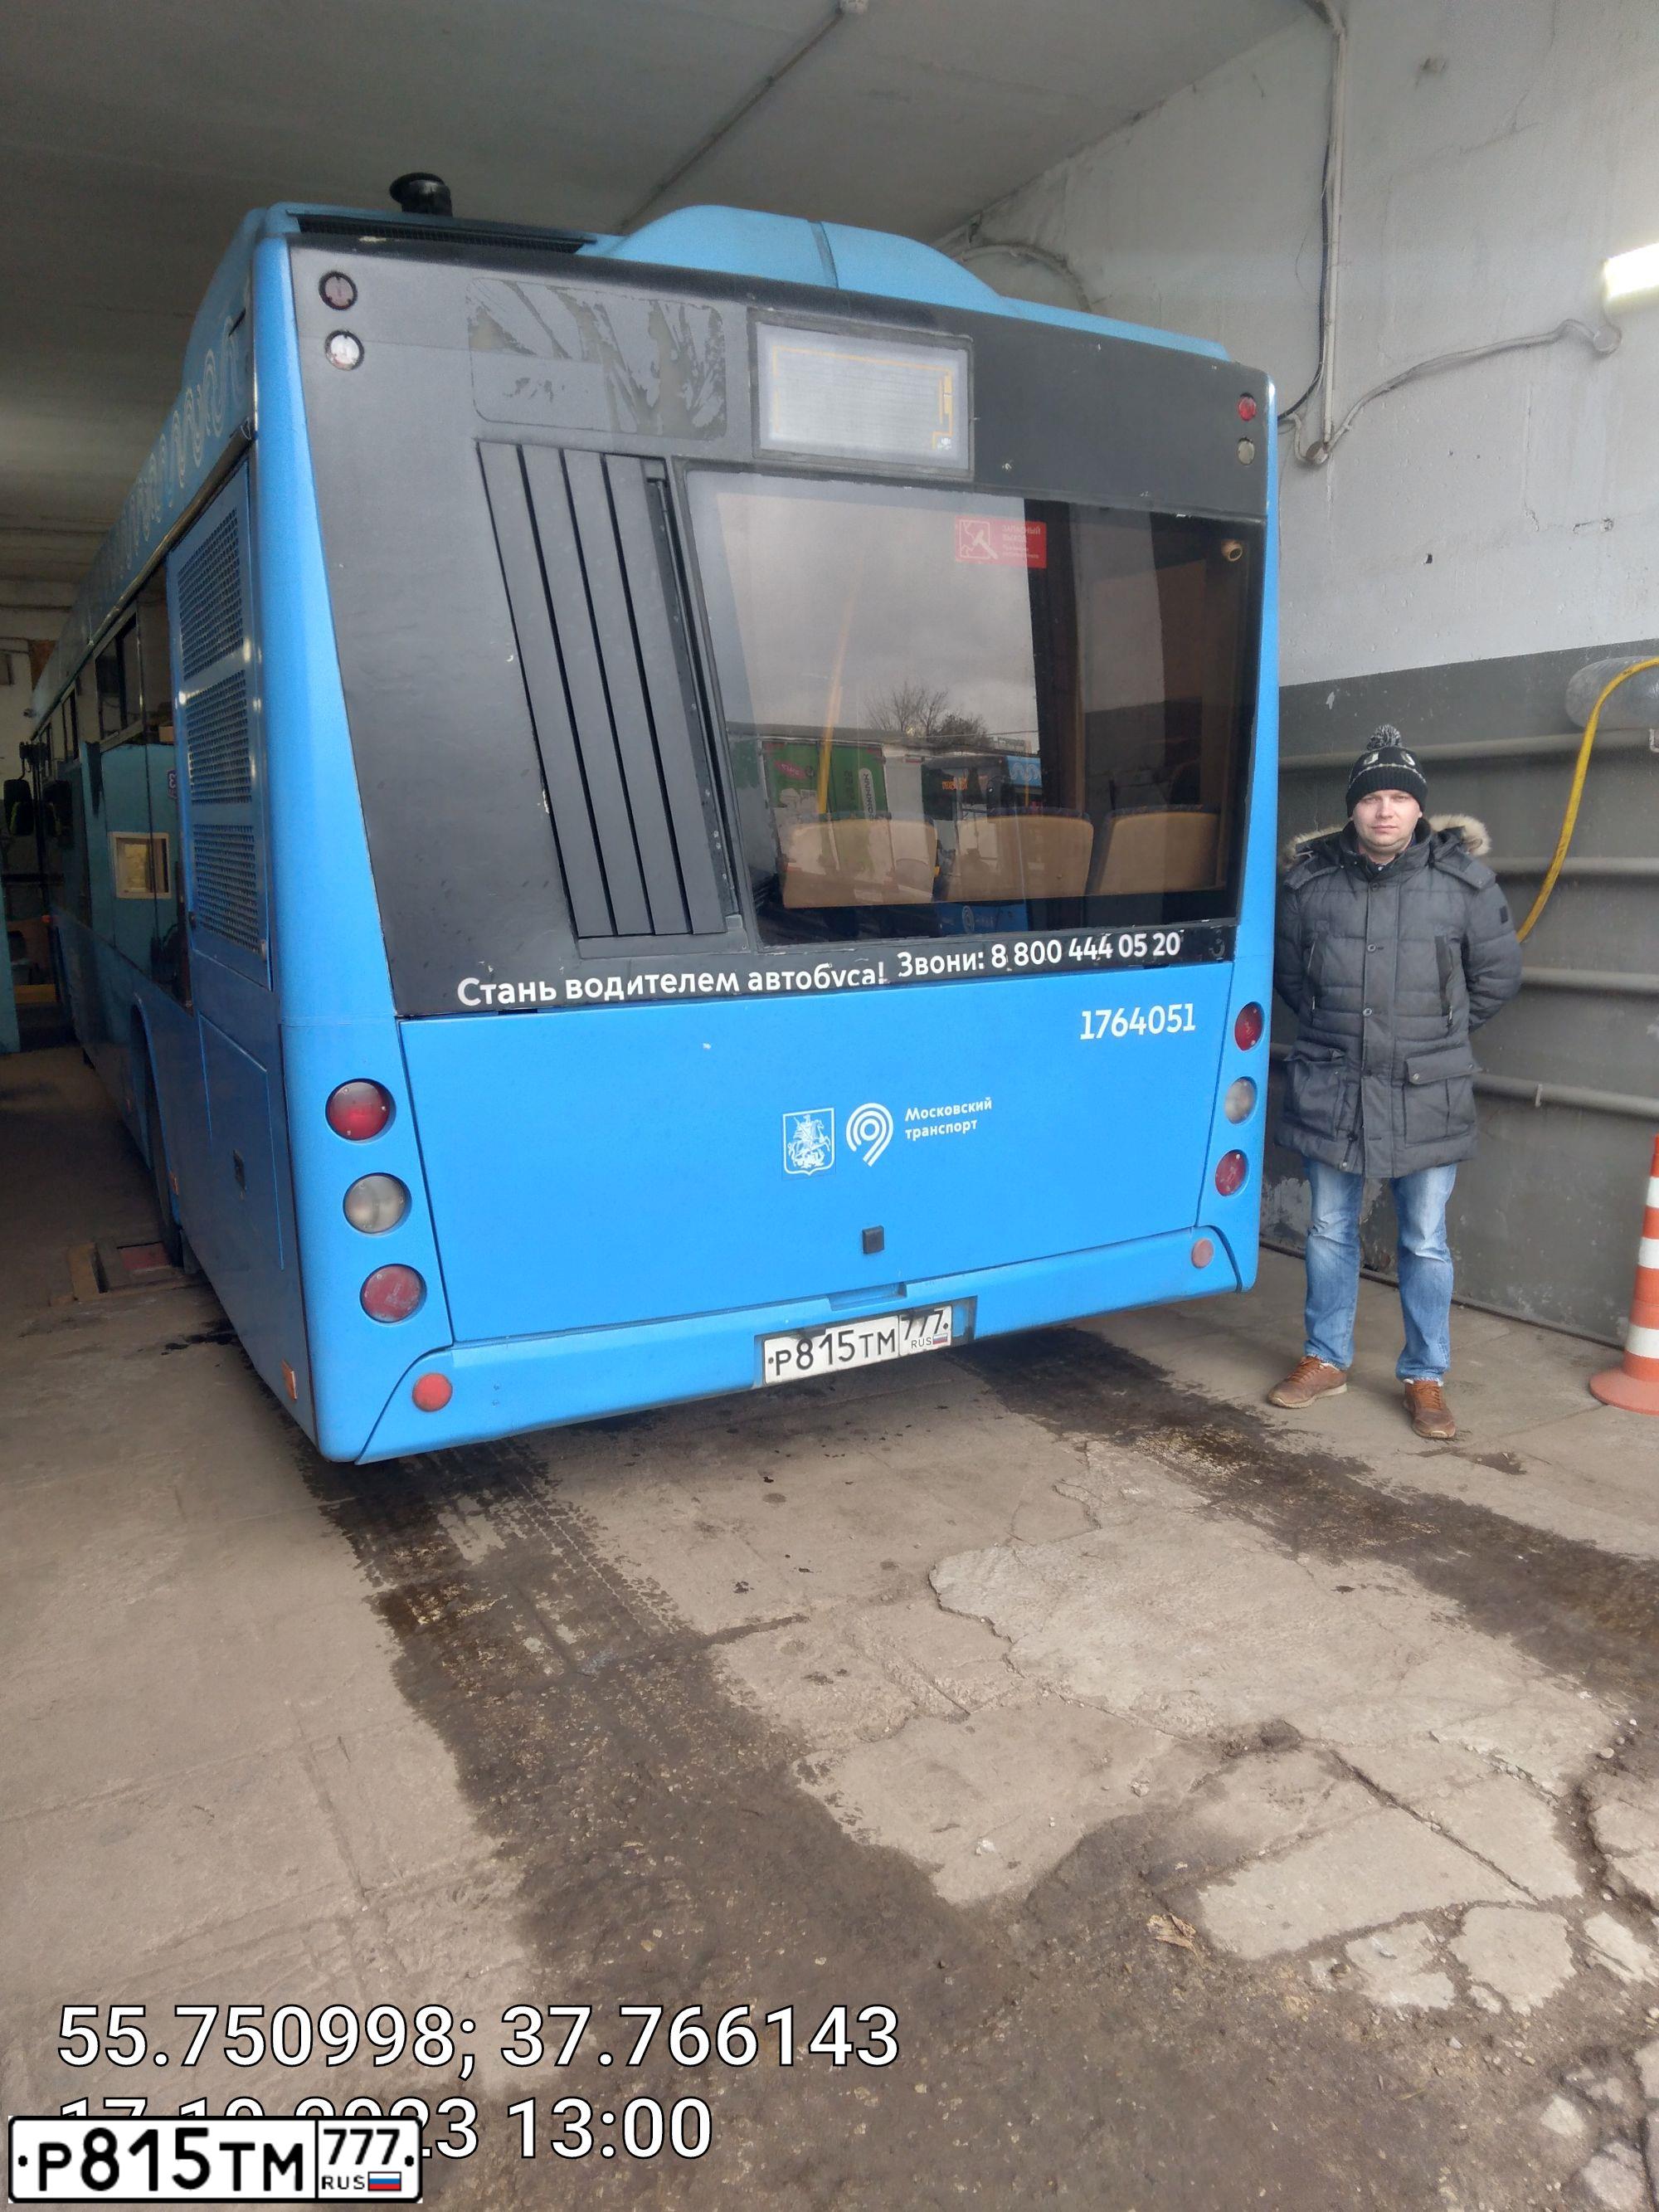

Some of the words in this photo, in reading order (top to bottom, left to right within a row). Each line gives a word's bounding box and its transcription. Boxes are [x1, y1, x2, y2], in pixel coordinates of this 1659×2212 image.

[458, 977, 557, 1006] Стань
[566, 969, 740, 1001] водителем
[897, 951, 985, 978] Звони:
[991, 943, 1008, 968] 8
[1014, 939, 1063, 967] 800
[1068, 933, 1113, 962] 444
[1118, 933, 1148, 958] 05
[1152, 932, 1181, 957] 20
[1080, 1003, 1196, 1040] 1764051
[904, 1097, 992, 1122] Московский
[905, 1120, 977, 1141] транспорт
[776, 1328, 895, 1376] Р815ТМ
[902, 1308, 944, 1341] 777
[912, 1337, 932, 1349] RUS
